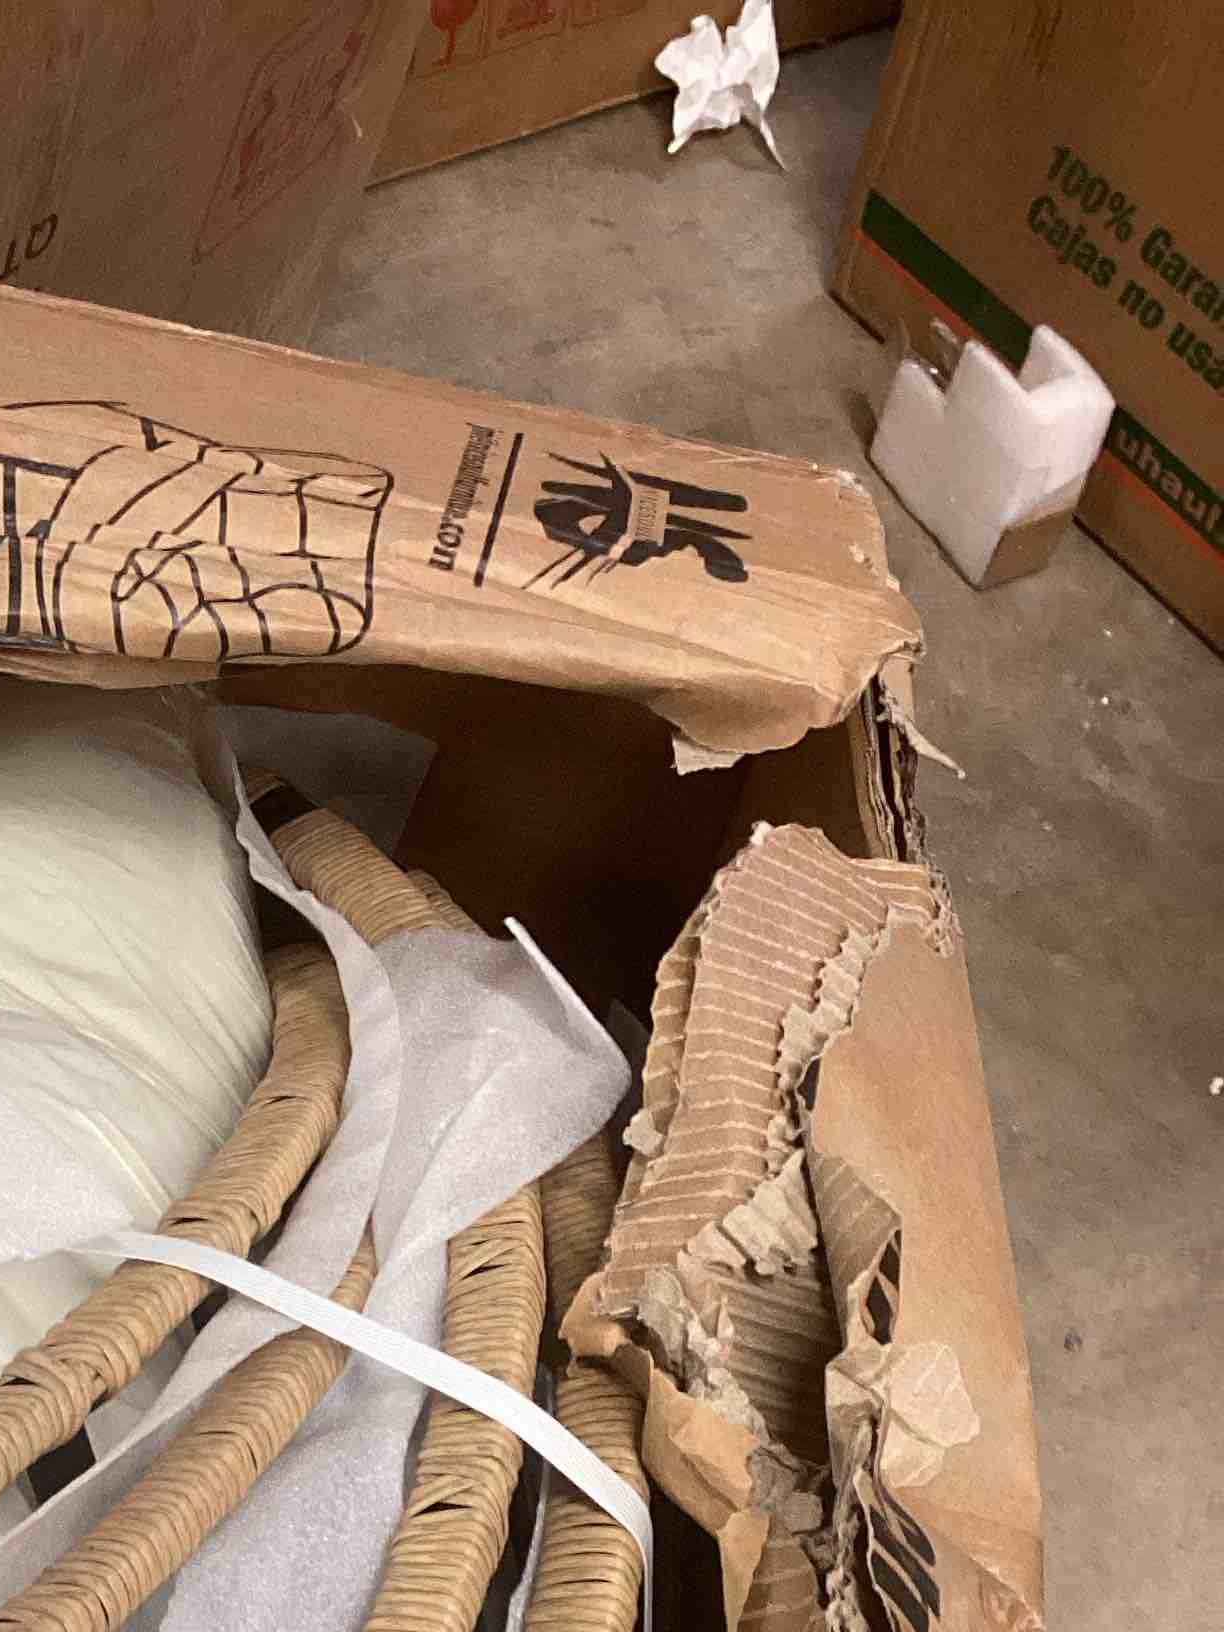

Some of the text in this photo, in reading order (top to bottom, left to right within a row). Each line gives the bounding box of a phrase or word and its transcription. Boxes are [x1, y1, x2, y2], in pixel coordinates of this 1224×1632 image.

[1047, 145, 1136, 243] 100%
[1028, 195, 1116, 290] Cajas
[1118, 280, 1164, 329] no
